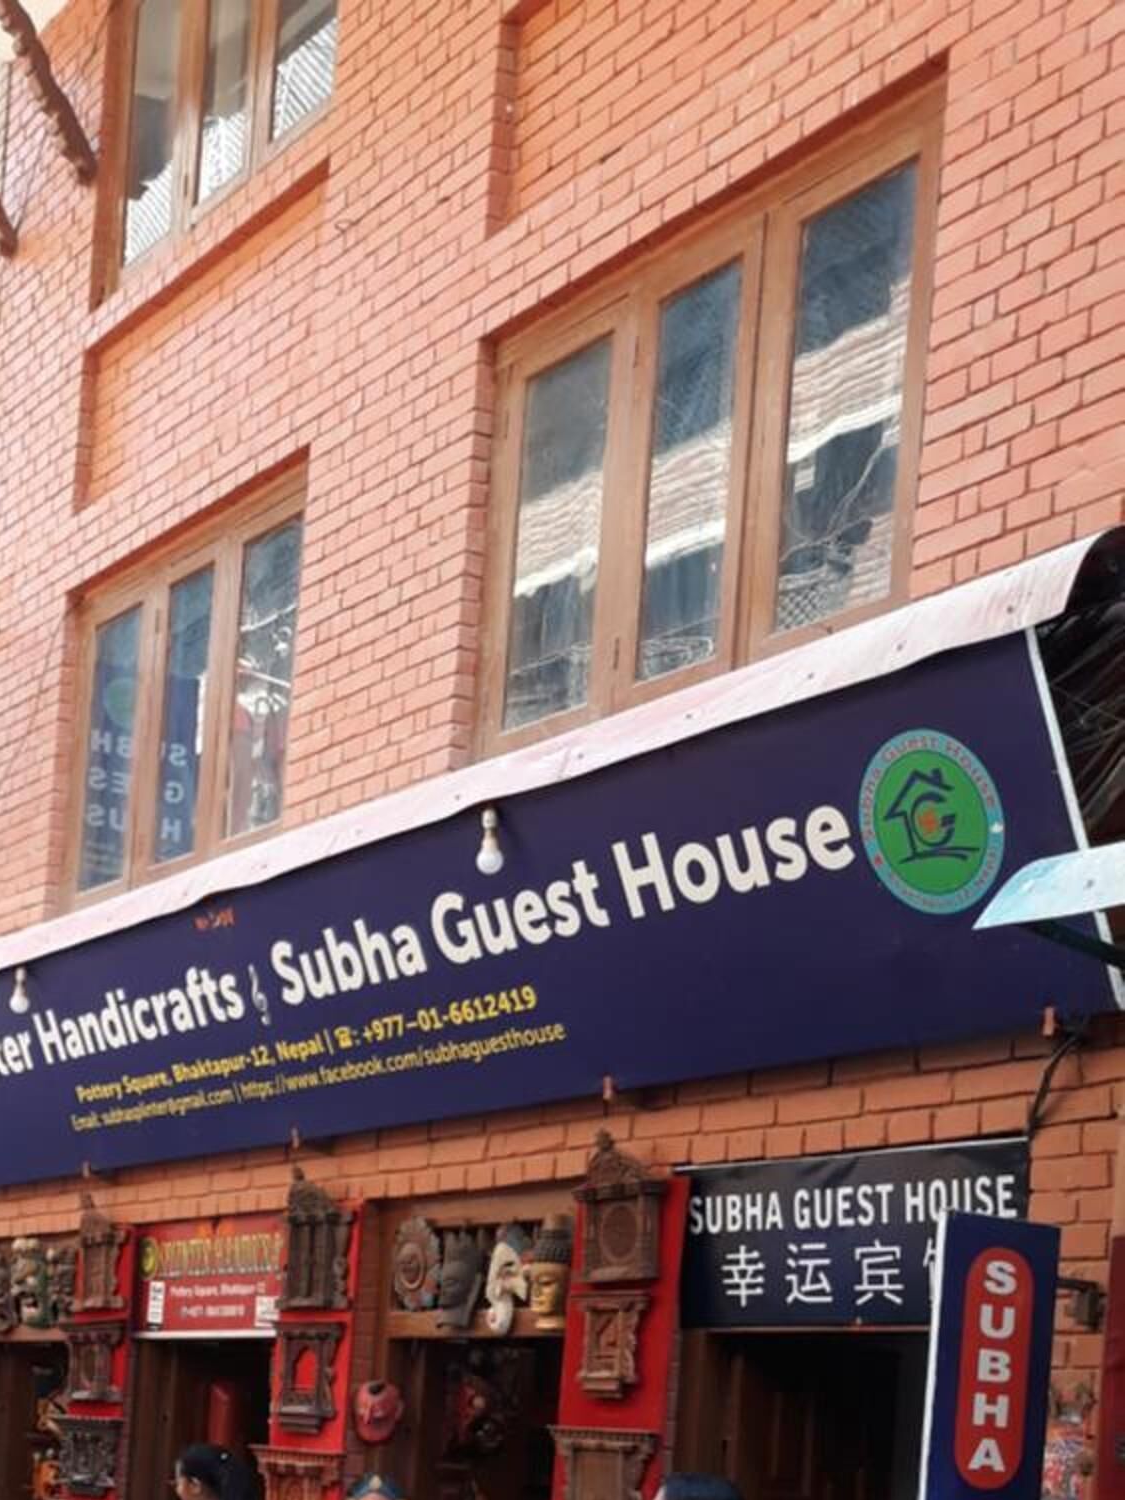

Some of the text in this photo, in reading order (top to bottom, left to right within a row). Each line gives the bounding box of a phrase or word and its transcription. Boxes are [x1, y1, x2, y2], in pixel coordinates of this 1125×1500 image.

[33, 966, 245, 1065] Handicrafts
[271, 918, 427, 1005] Subha
[432, 860, 610, 964] Guest
[612, 804, 856, 920] House
[275, 1033, 324, 1062] Nepal
[689, 1174, 1018, 1235] SUBHA GUEST HOUSE
[968, 1259, 1018, 1472] SUBHA
